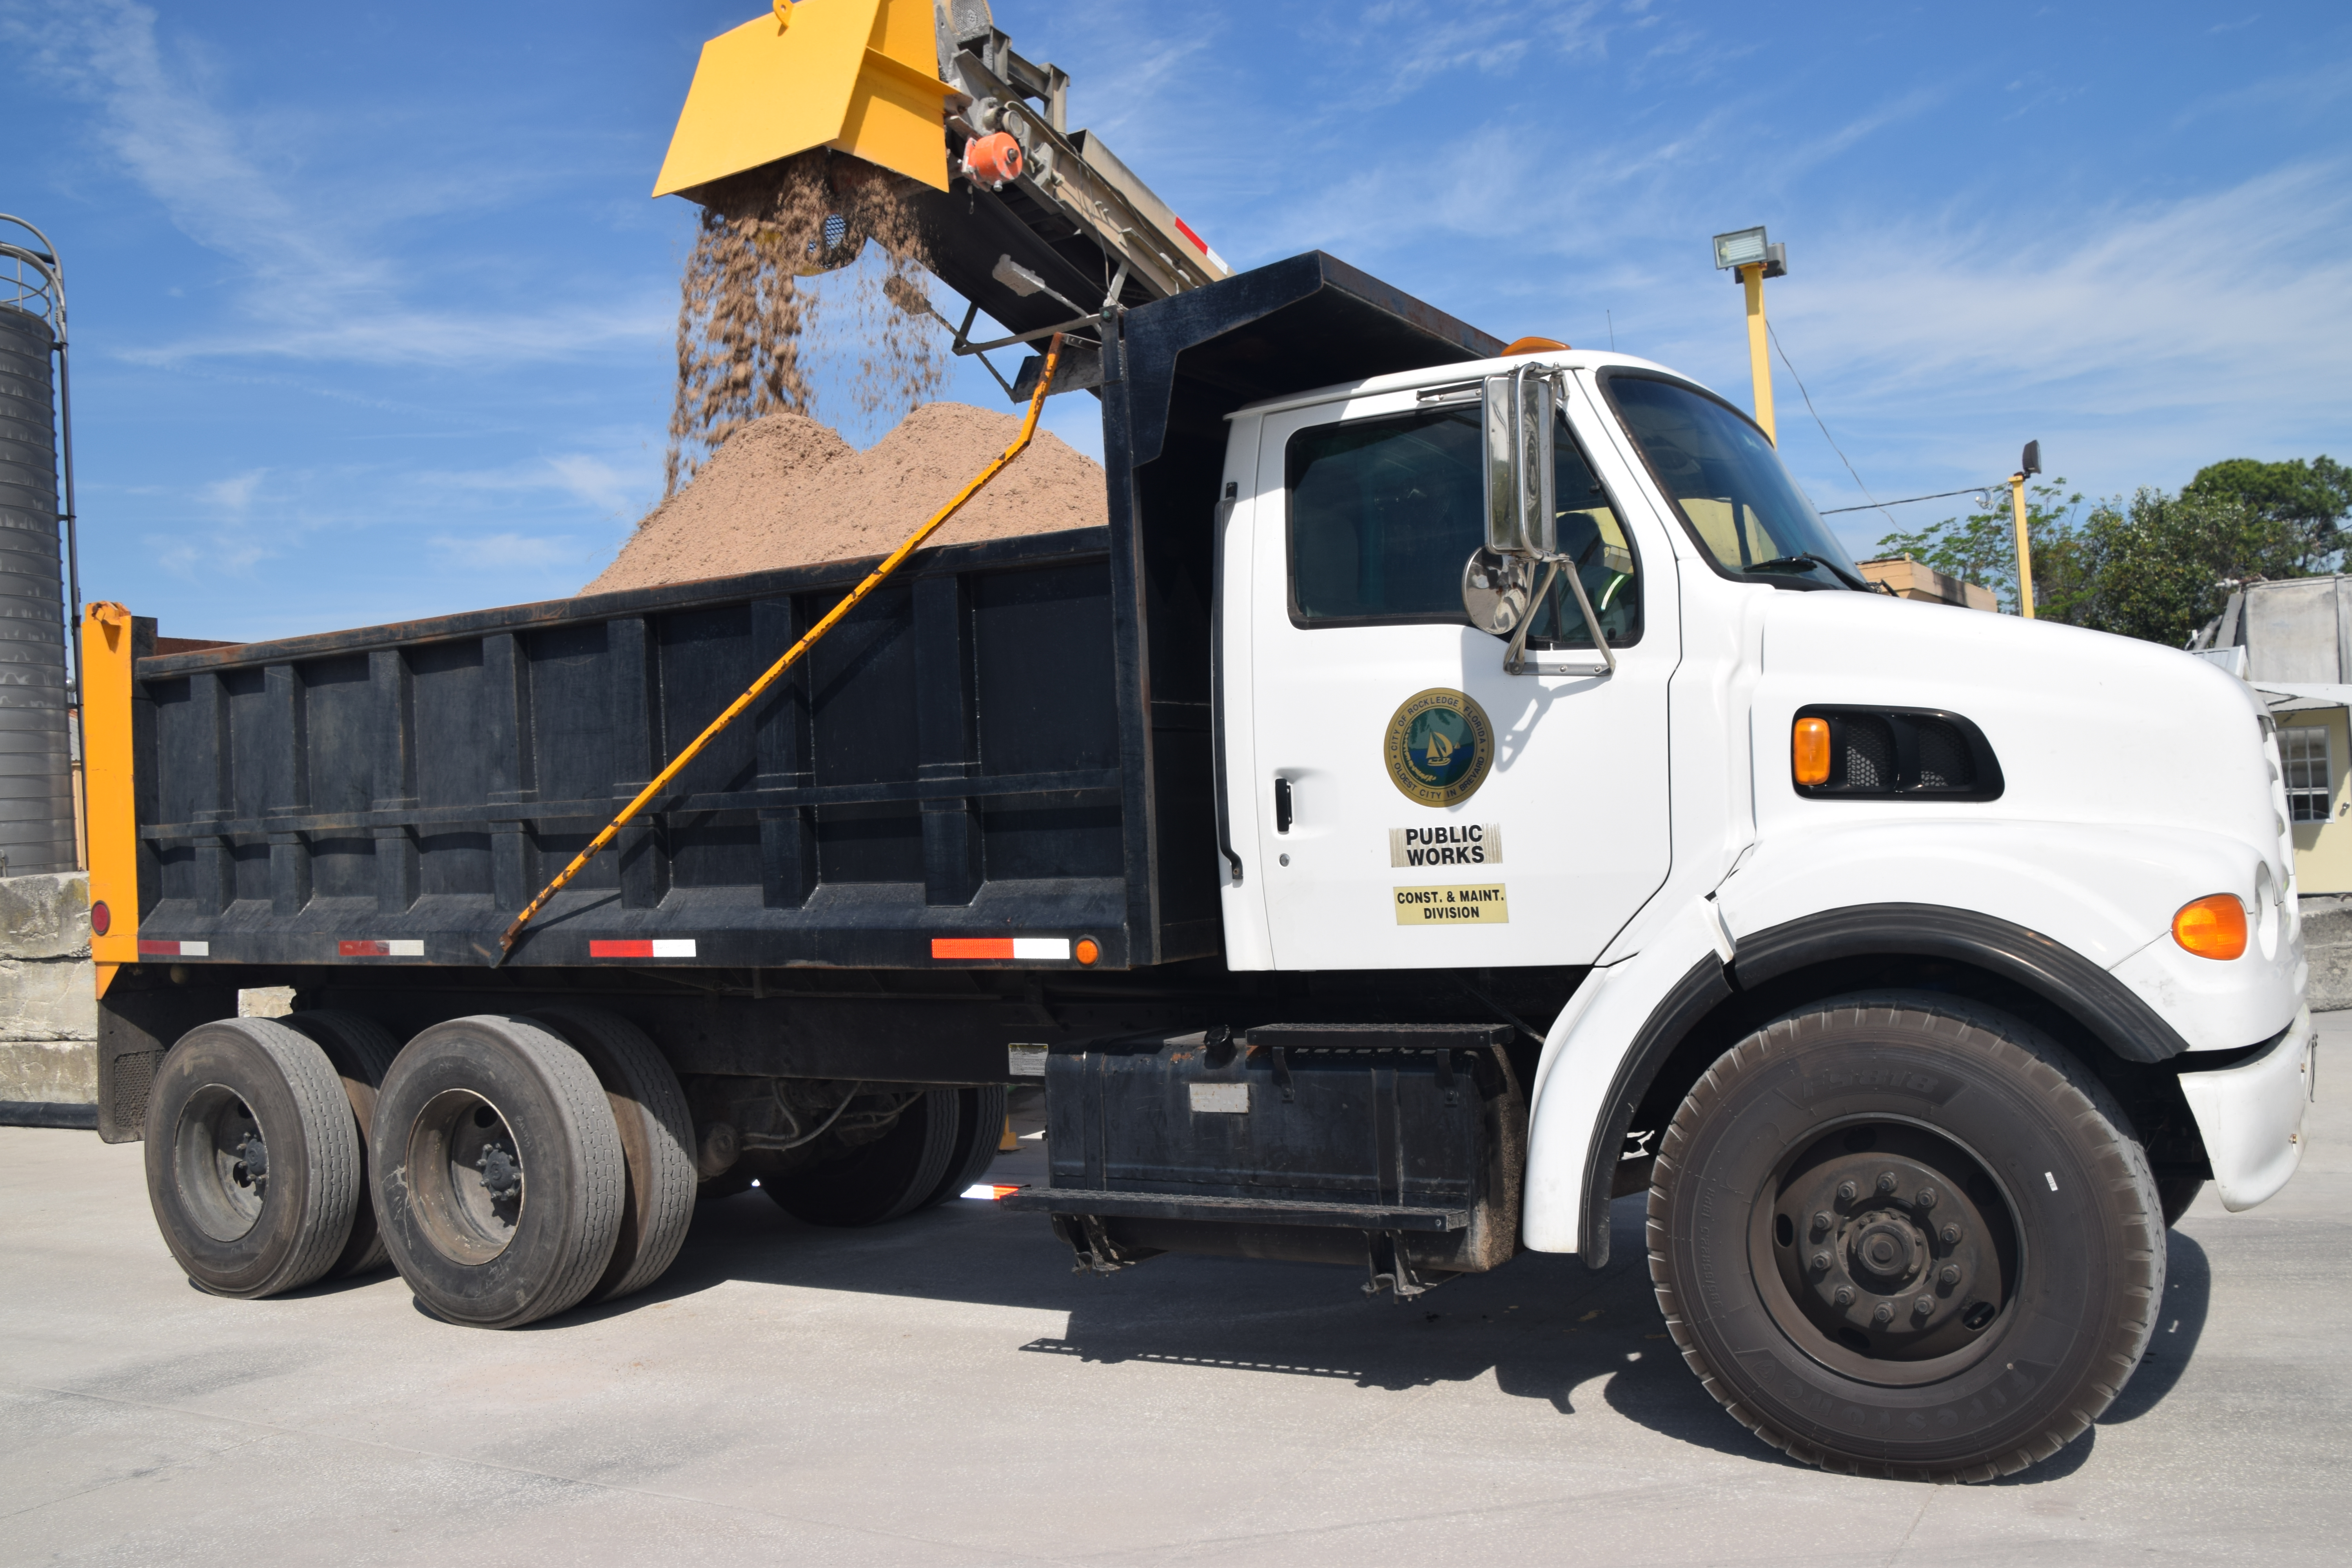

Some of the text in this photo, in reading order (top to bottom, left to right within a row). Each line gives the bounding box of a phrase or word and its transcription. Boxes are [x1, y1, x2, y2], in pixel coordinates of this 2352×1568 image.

[1391, 730, 1400, 751] CITY
[1398, 715, 1406, 727] OF
[1463, 706, 1486, 744] FLORIDA
[1394, 757, 1485, 799] OLDEST CITY IN BREVARD
[1406, 825, 1483, 846] PUBLIC
[1406, 846, 1485, 866] WORKS
[1397, 889, 1504, 904] CONST. & MAINT.
[1424, 906, 1480, 919] DIVISION
[1803, 1069, 1938, 1099] FS818
[1782, 1367, 2036, 1435] Firestone
